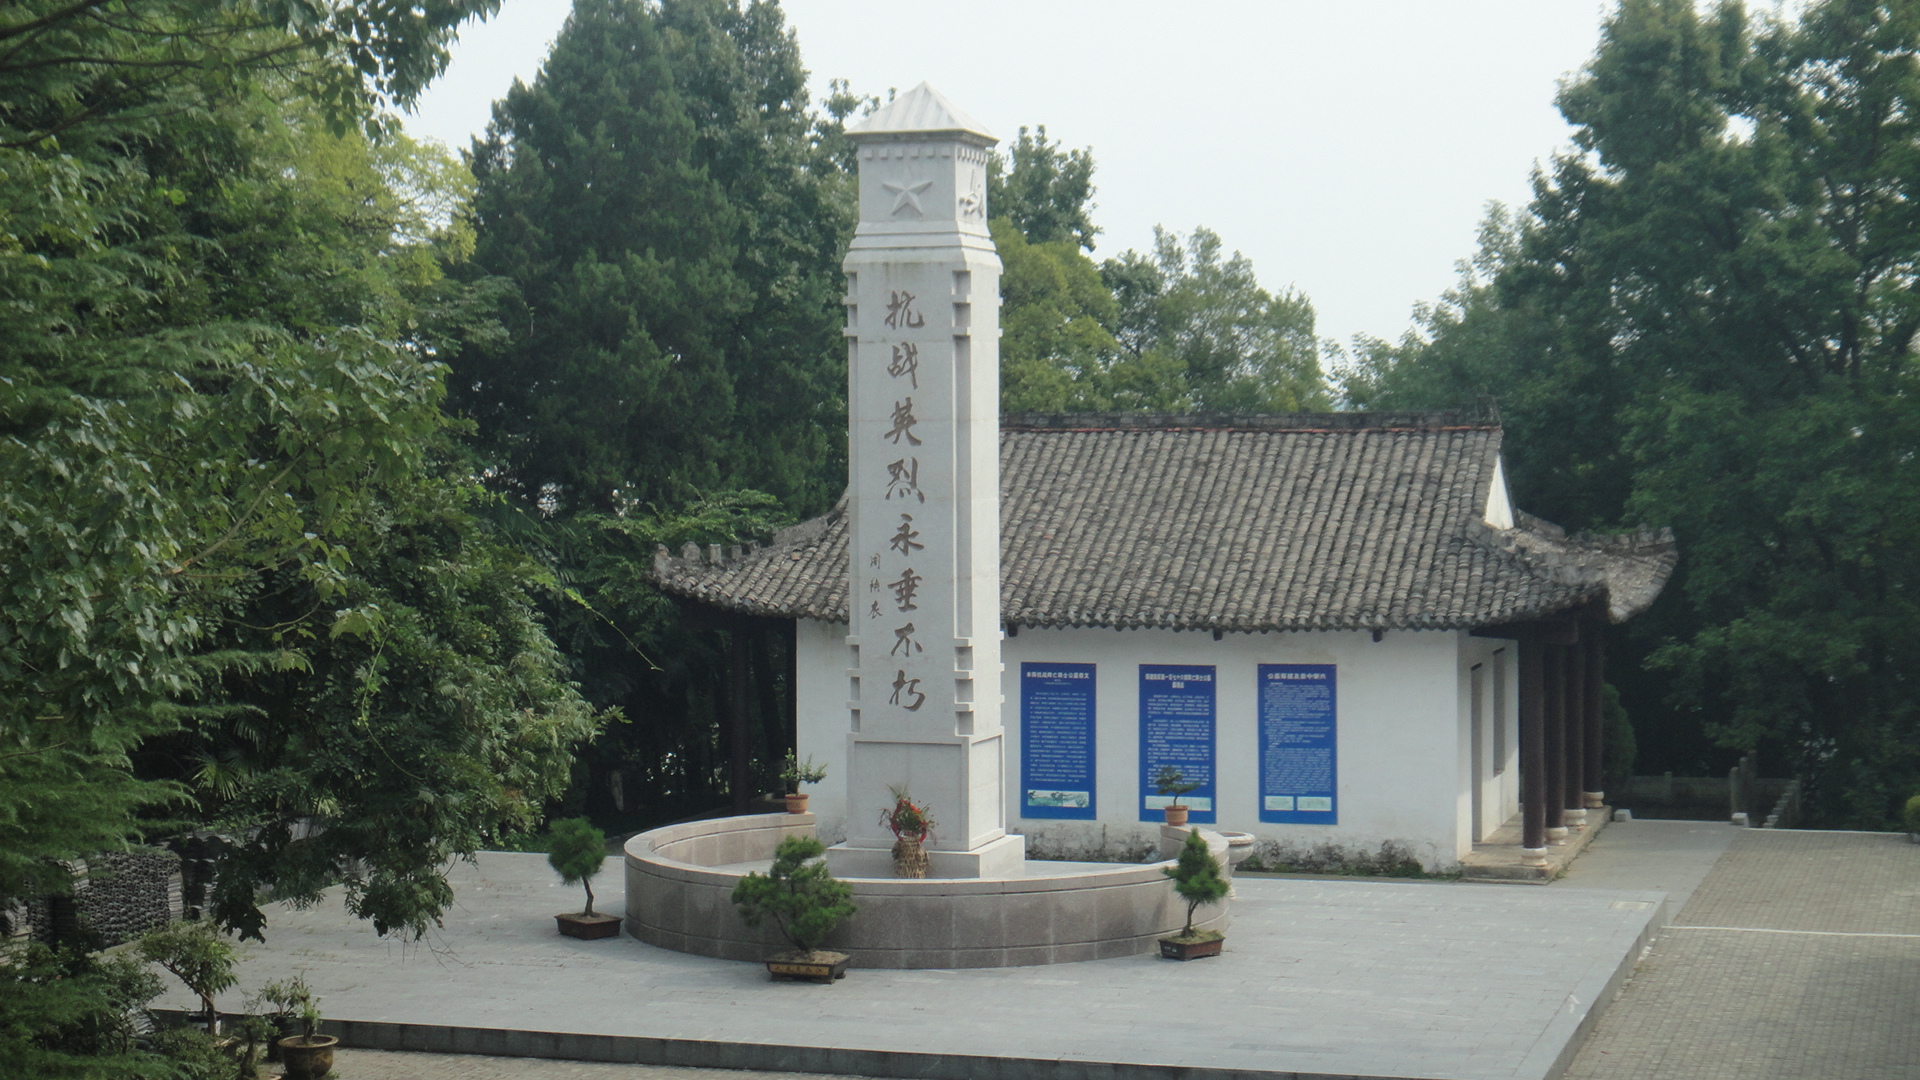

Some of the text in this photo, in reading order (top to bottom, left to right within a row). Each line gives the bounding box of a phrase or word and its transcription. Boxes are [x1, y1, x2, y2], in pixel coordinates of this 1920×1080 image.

[884, 290, 926, 712] 抗战英烈永垂不朽
